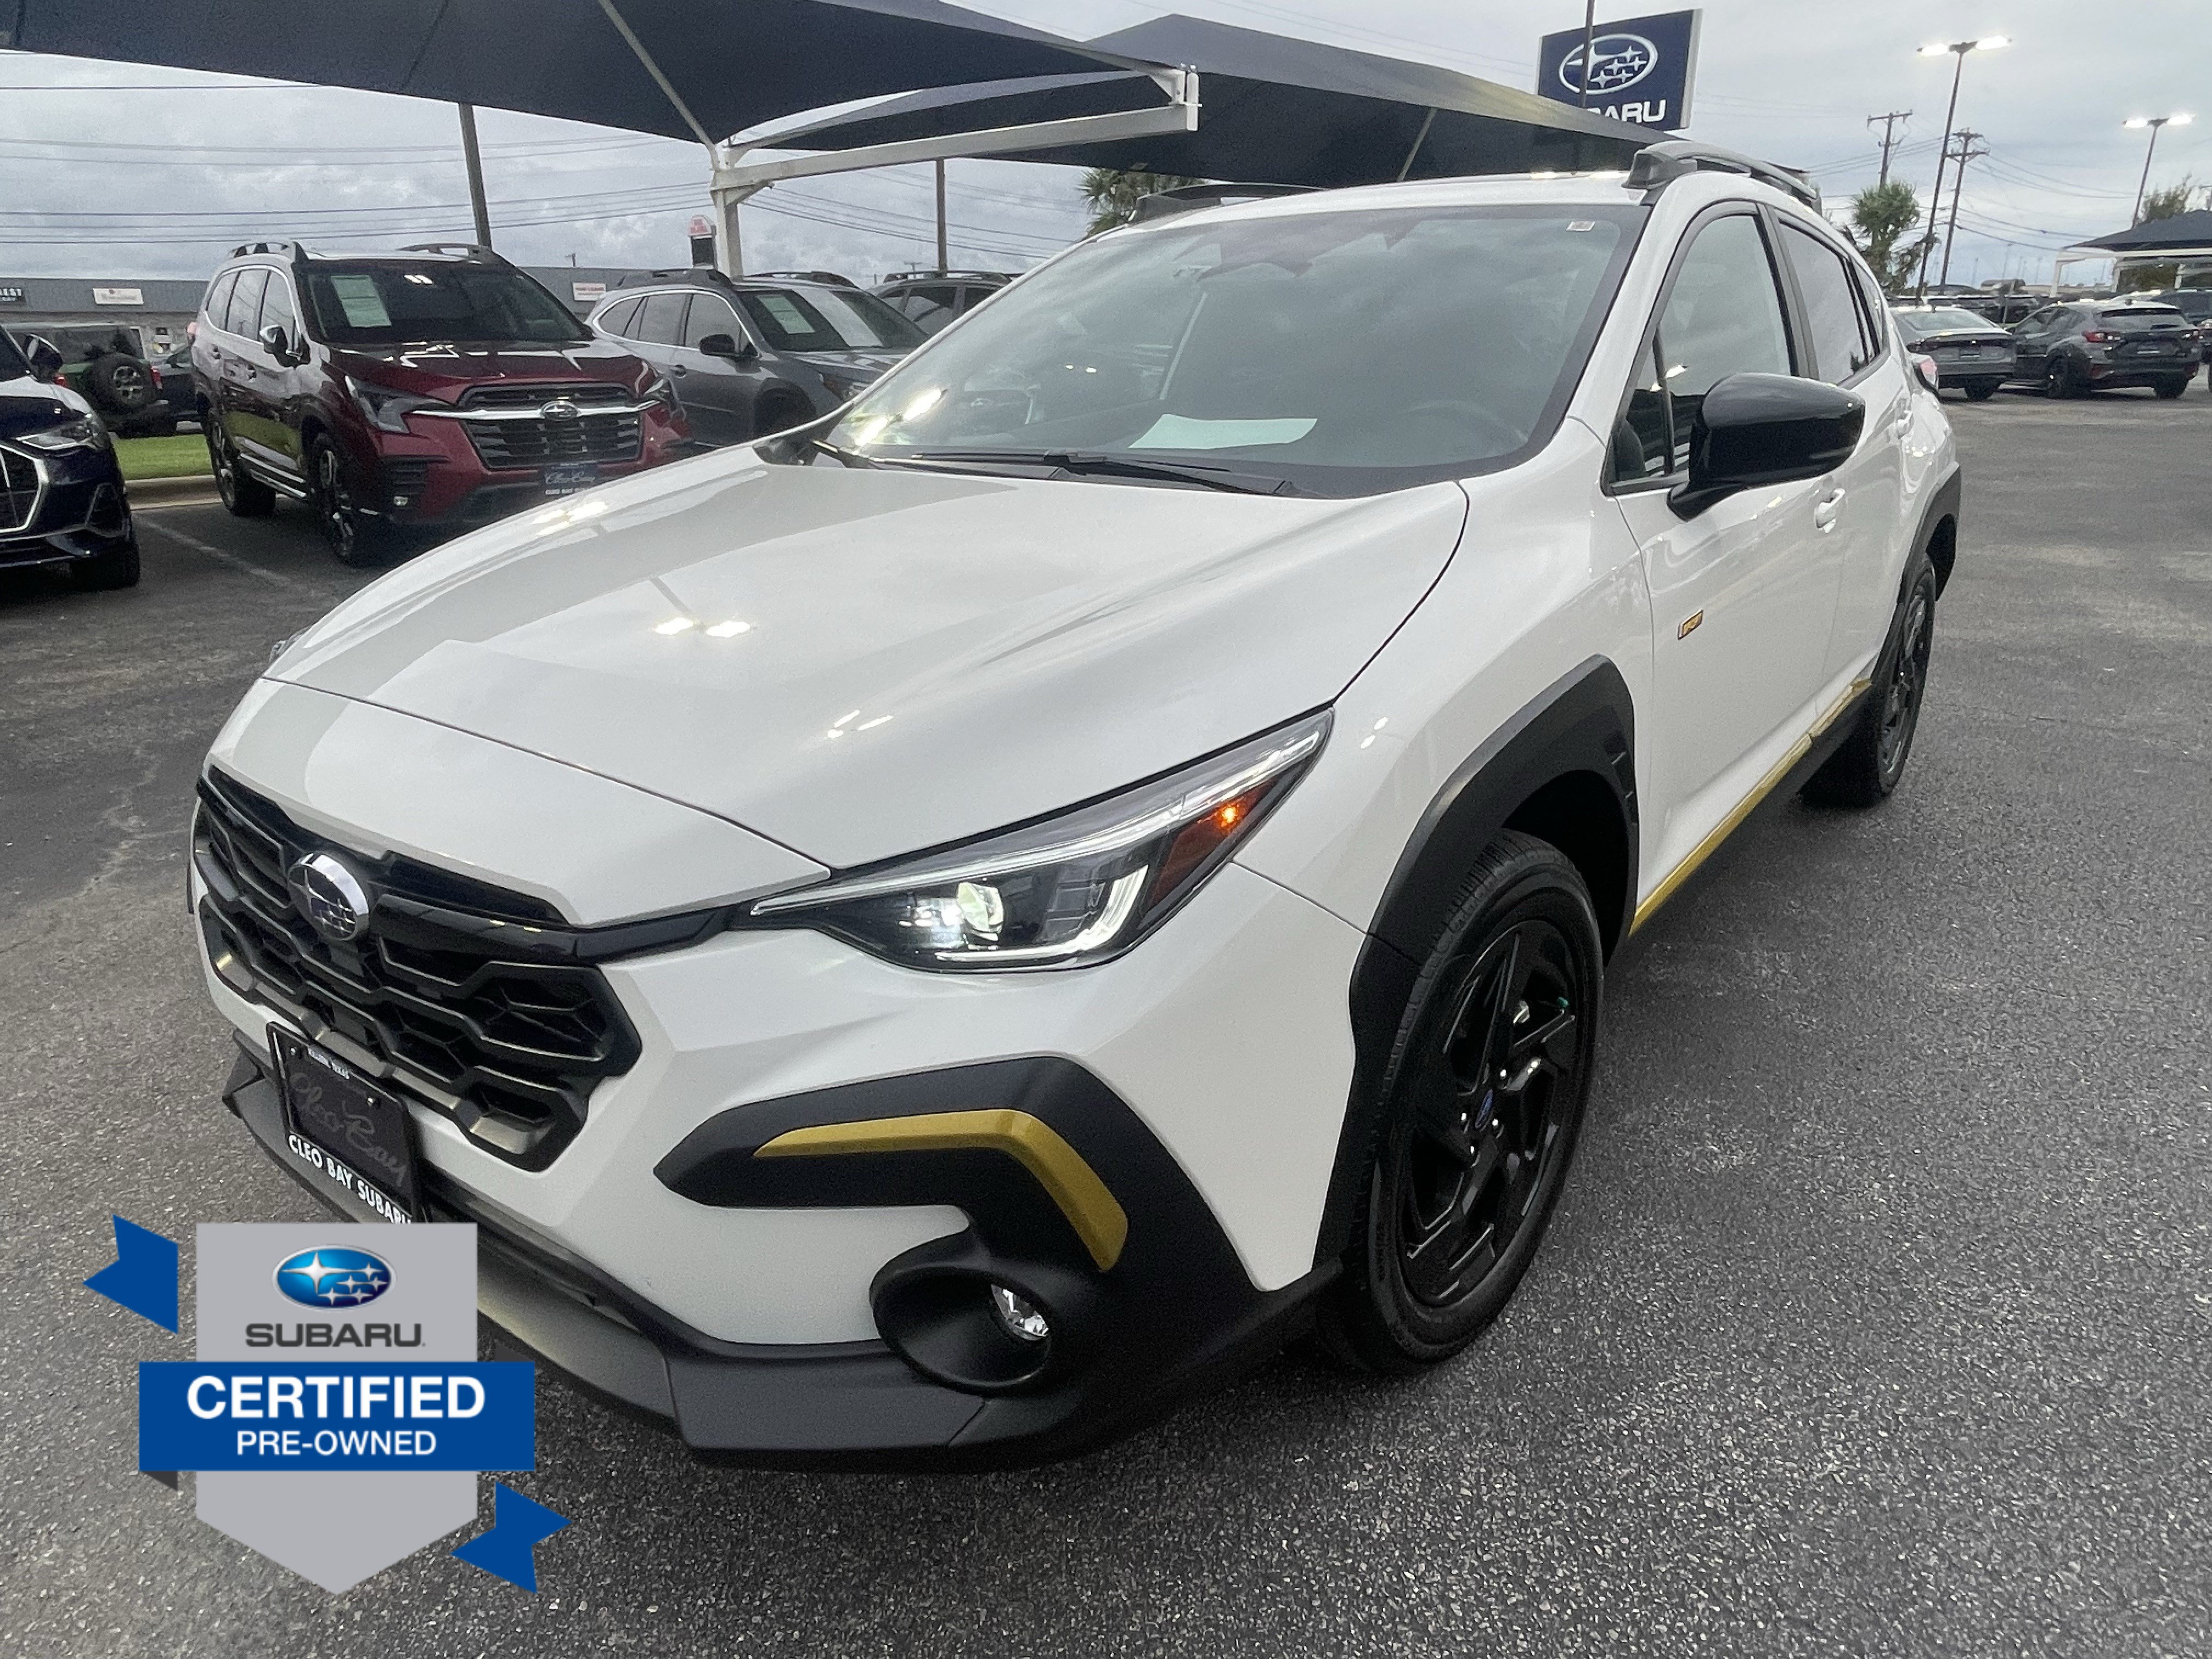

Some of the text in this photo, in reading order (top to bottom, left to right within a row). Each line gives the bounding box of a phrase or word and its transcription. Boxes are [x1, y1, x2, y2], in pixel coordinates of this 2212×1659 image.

[1587, 99, 1667, 123] ARU
[289, 1134, 323, 1169] CLEO
[326, 1158, 353, 1190] BAY
